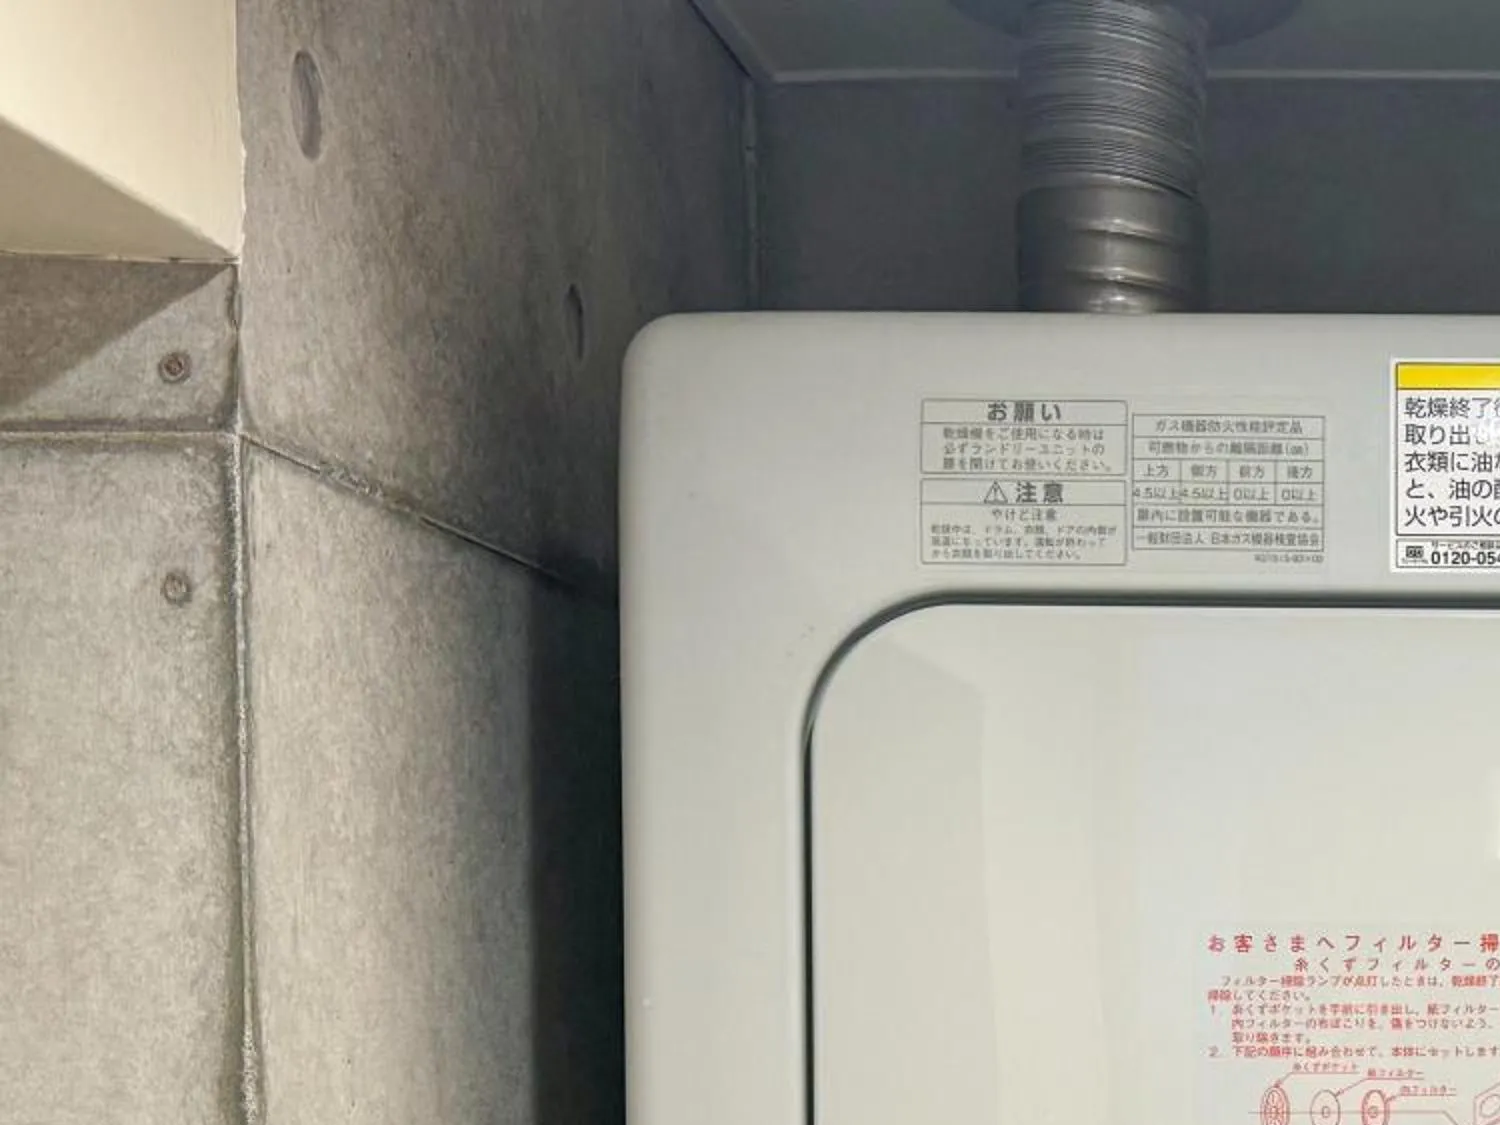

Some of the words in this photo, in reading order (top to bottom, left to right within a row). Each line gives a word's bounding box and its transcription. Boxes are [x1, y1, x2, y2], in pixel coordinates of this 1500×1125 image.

[986, 401, 1062, 422] お願い
[1144, 464, 1169, 478] 上方
[1016, 481, 1063, 503] 注意
